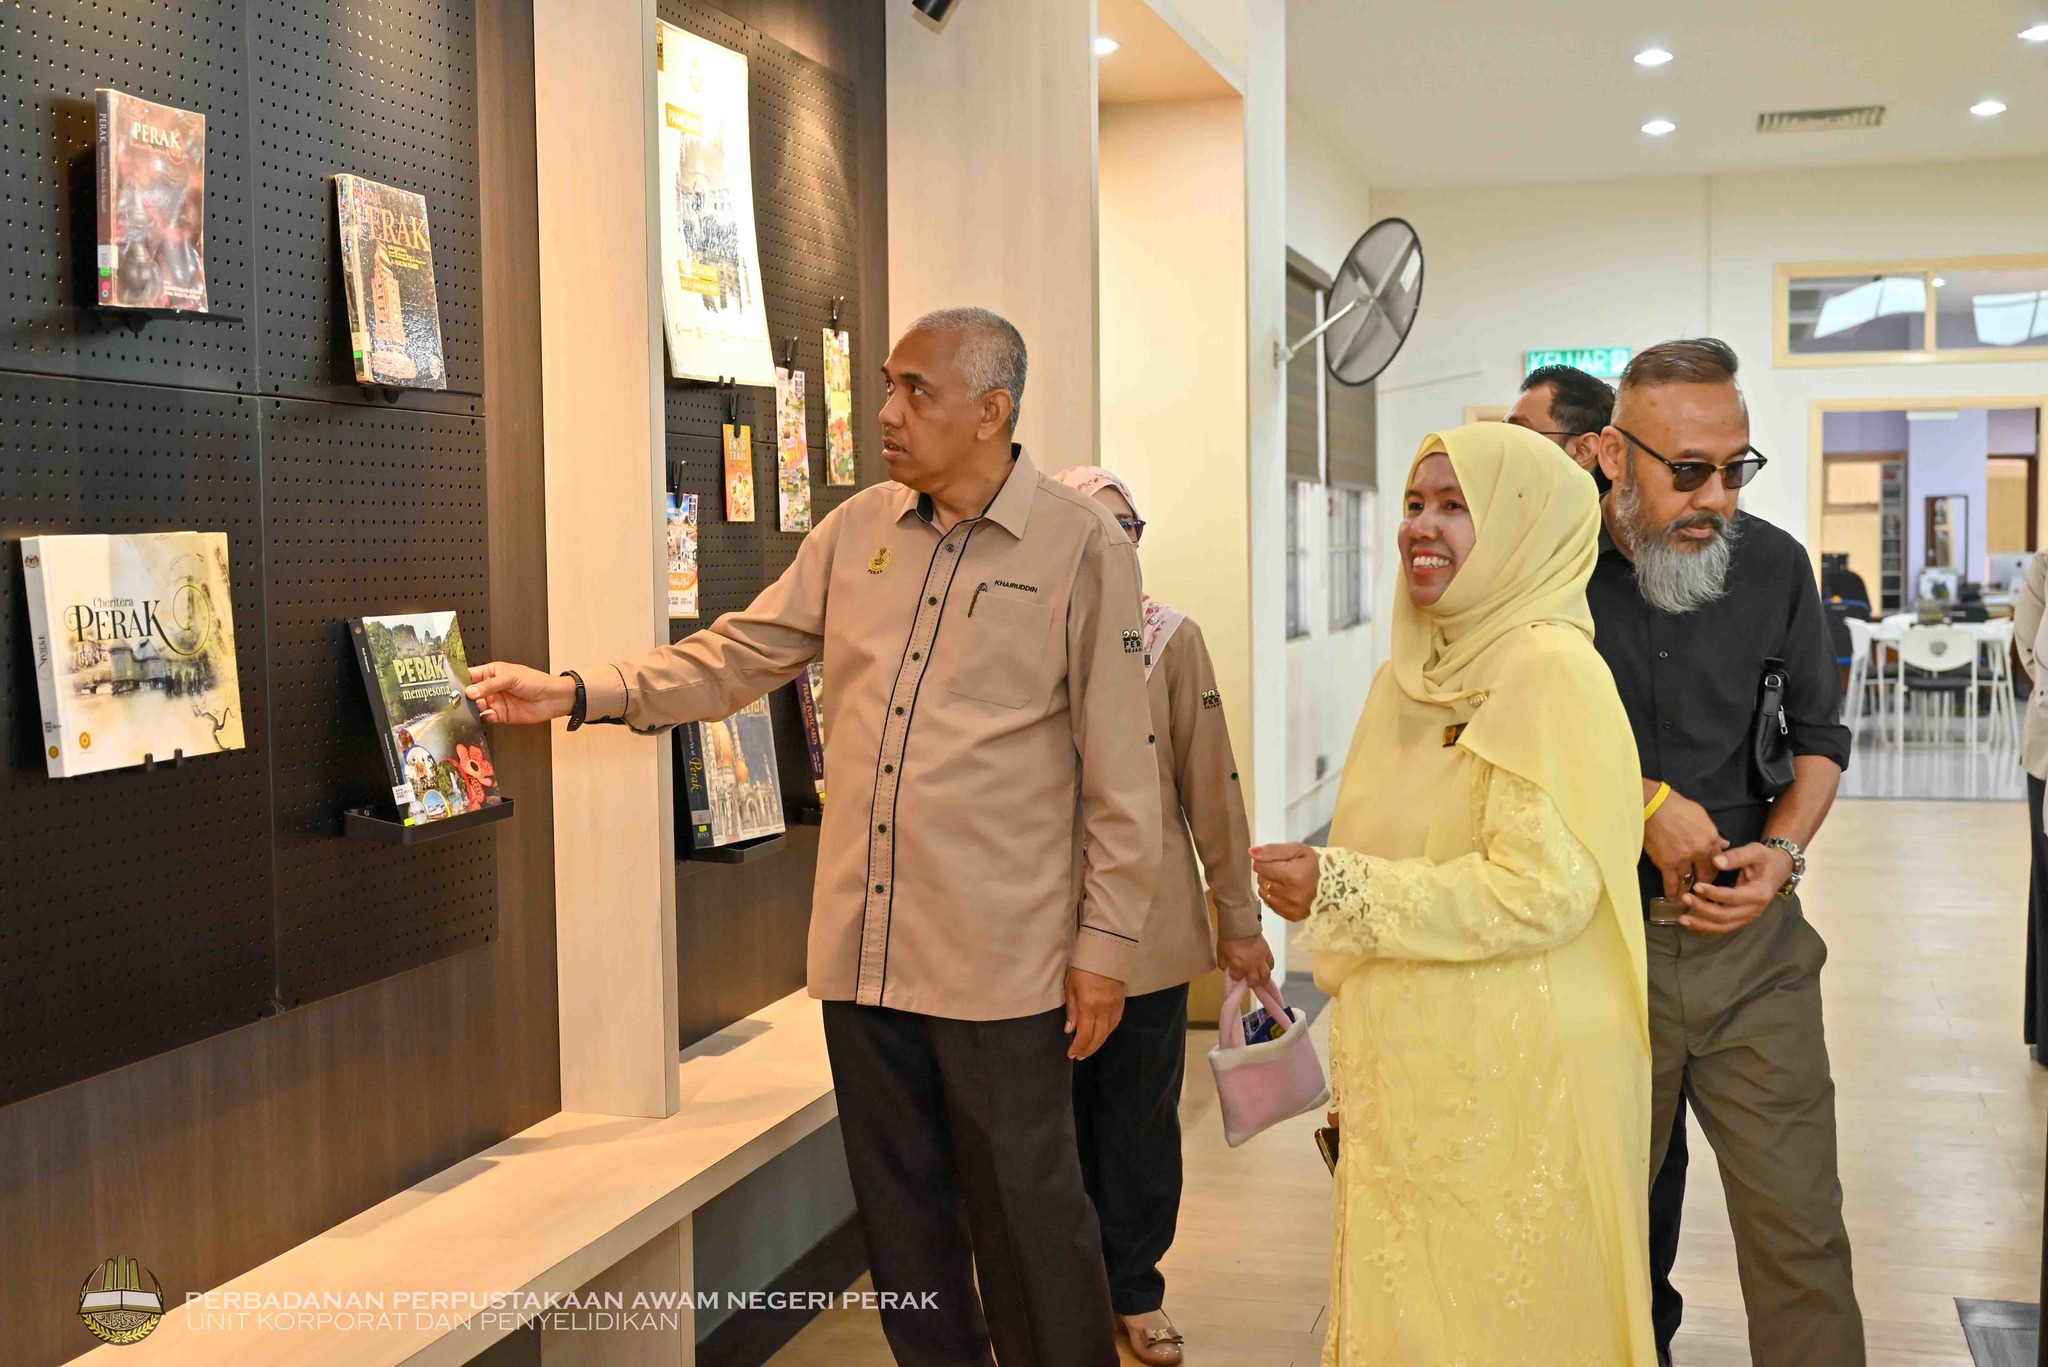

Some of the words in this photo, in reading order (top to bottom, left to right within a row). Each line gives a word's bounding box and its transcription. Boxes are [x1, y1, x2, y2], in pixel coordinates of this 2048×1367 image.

[98, 112, 107, 143] PERAK
[134, 121, 182, 149] PERAK
[729, 451, 747, 461] TRAIL
[994, 580, 1038, 593] KHAIRUDDIN
[63, 590, 198, 655] PERAK
[1123, 640, 1142, 649] PER
[393, 654, 447, 684] PERAK
[402, 685, 451, 701] mempesona
[803, 683, 811, 703] PERAK
[806, 703, 819, 745] POSTCARDS
[688, 757, 702, 793] Perak
